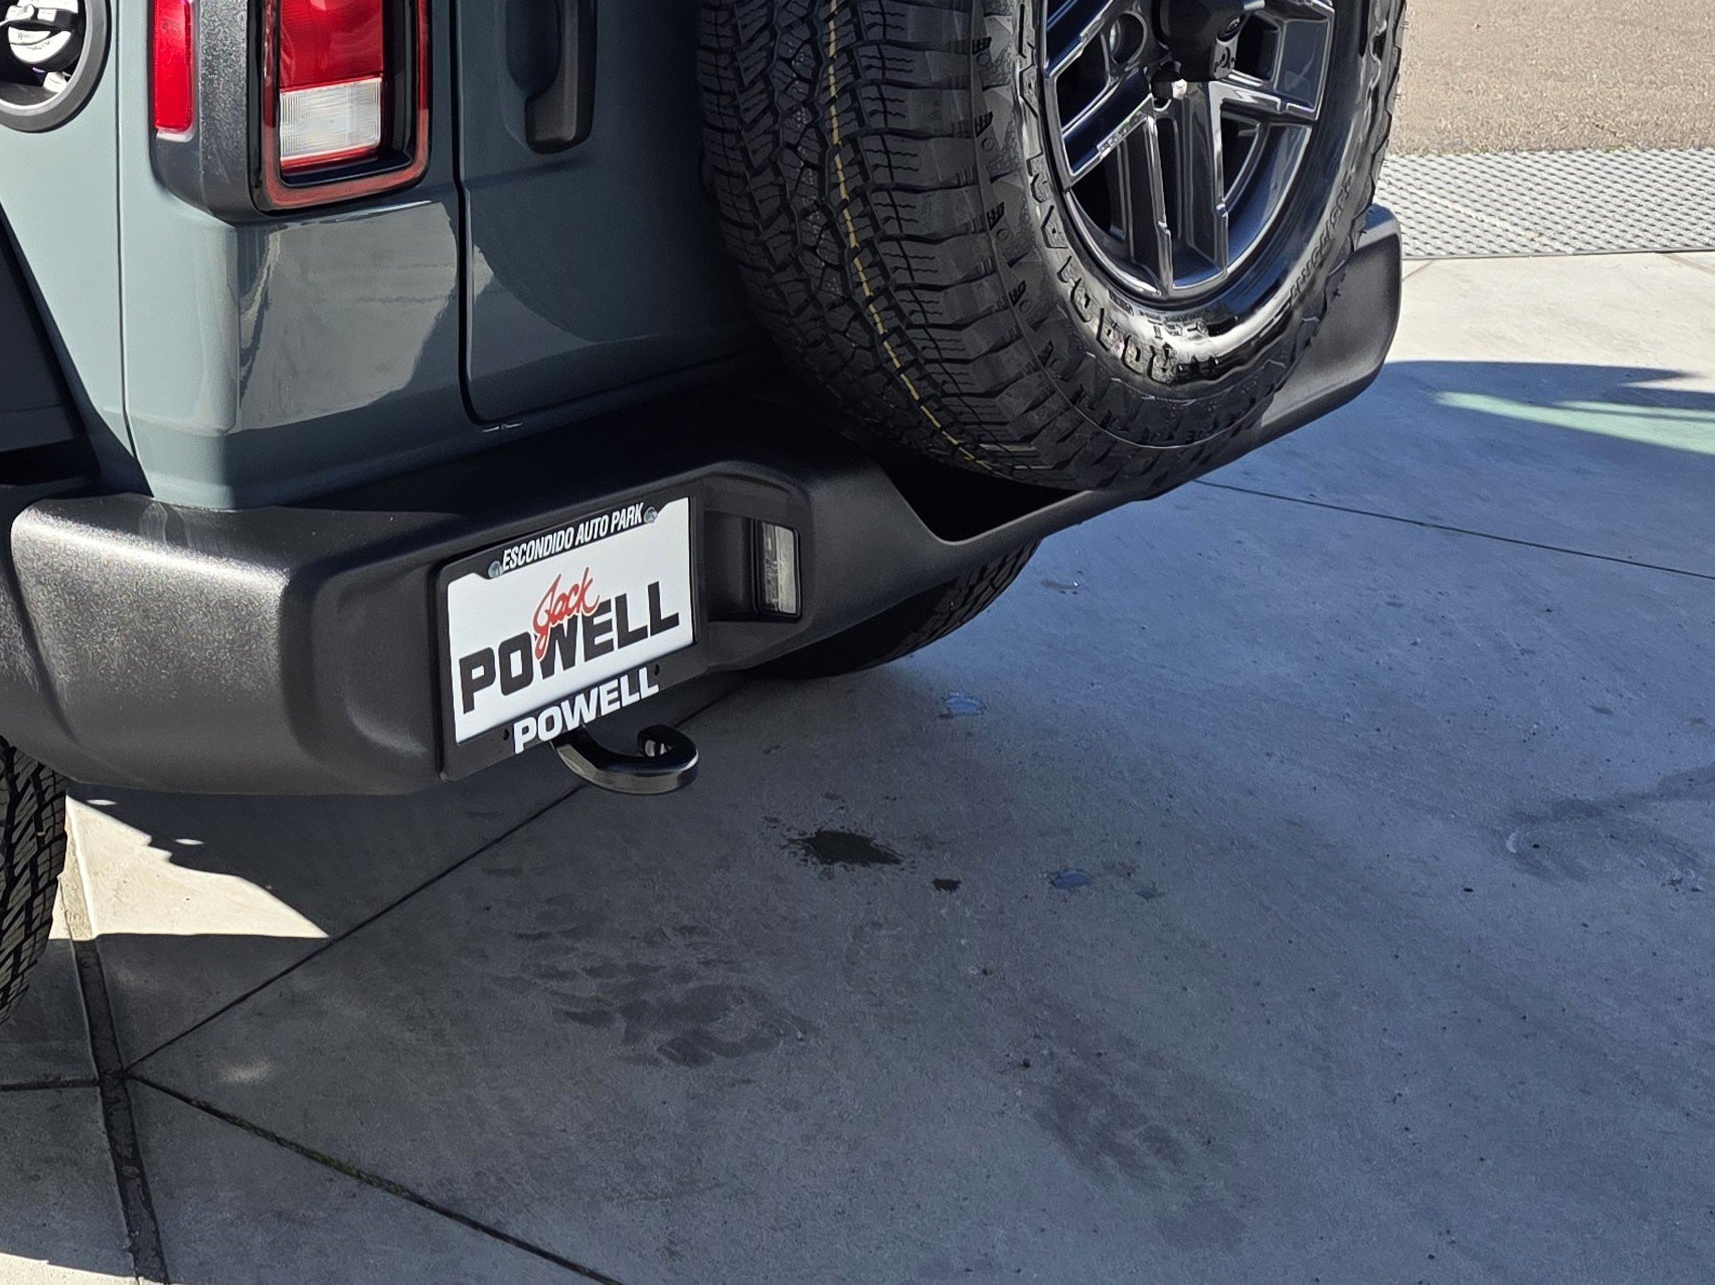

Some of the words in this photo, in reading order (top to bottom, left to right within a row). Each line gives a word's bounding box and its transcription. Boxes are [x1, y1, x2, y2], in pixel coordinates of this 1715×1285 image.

[502, 528, 574, 571] ESCONDIDO
[574, 513, 609, 545] AUTO
[610, 502, 645, 533] PARK
[458, 580, 680, 715] POWELL
[532, 566, 601, 661] Jack
[513, 666, 660, 755] POWELL
